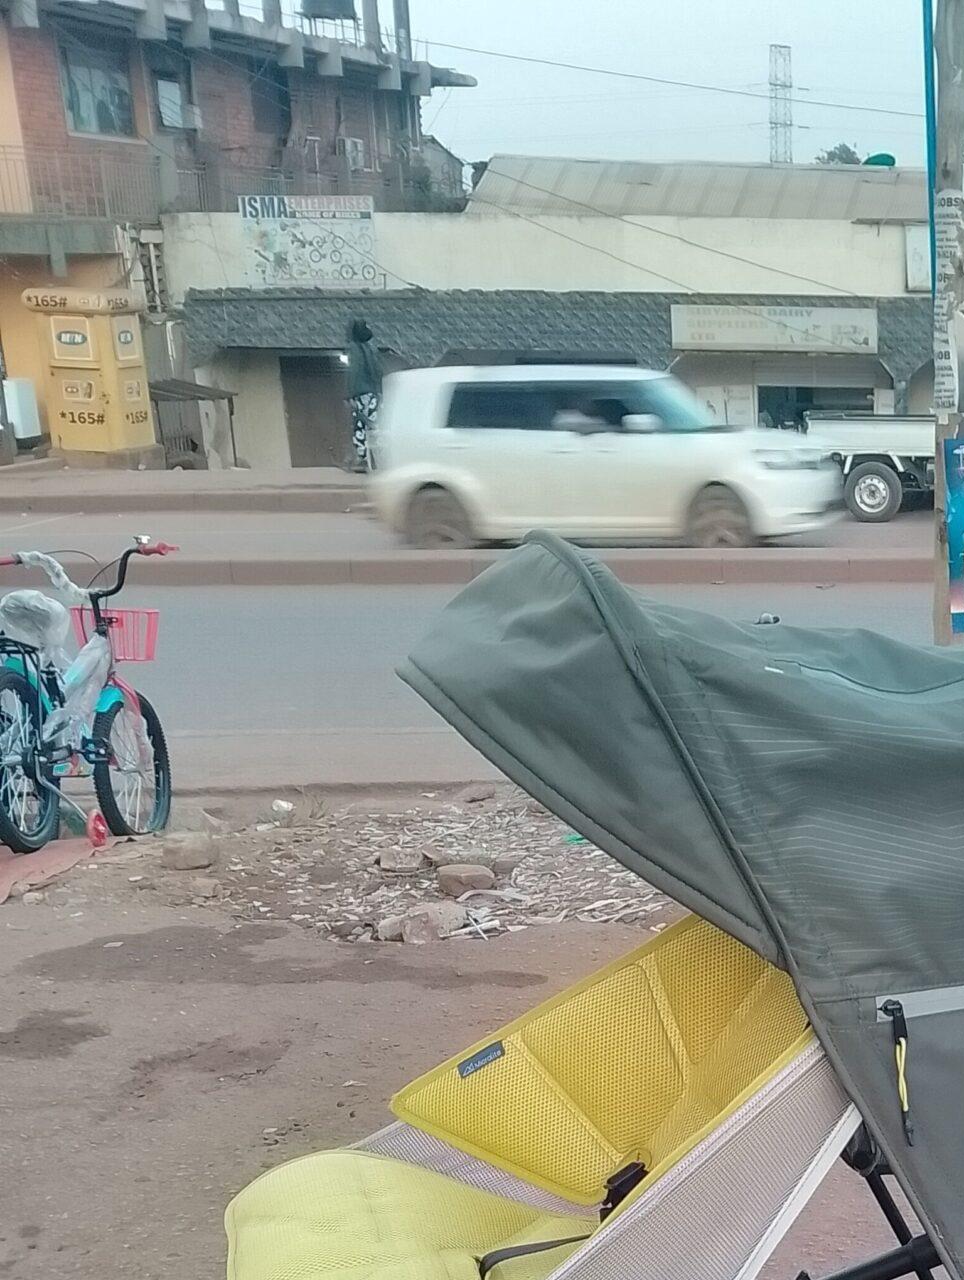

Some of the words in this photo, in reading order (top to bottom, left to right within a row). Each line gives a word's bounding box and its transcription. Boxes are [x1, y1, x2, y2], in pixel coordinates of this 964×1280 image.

[240, 196, 288, 219] ISMA
[288, 197, 371, 210] ENTERPRISES
[768, 308, 813, 317] DAIRY
